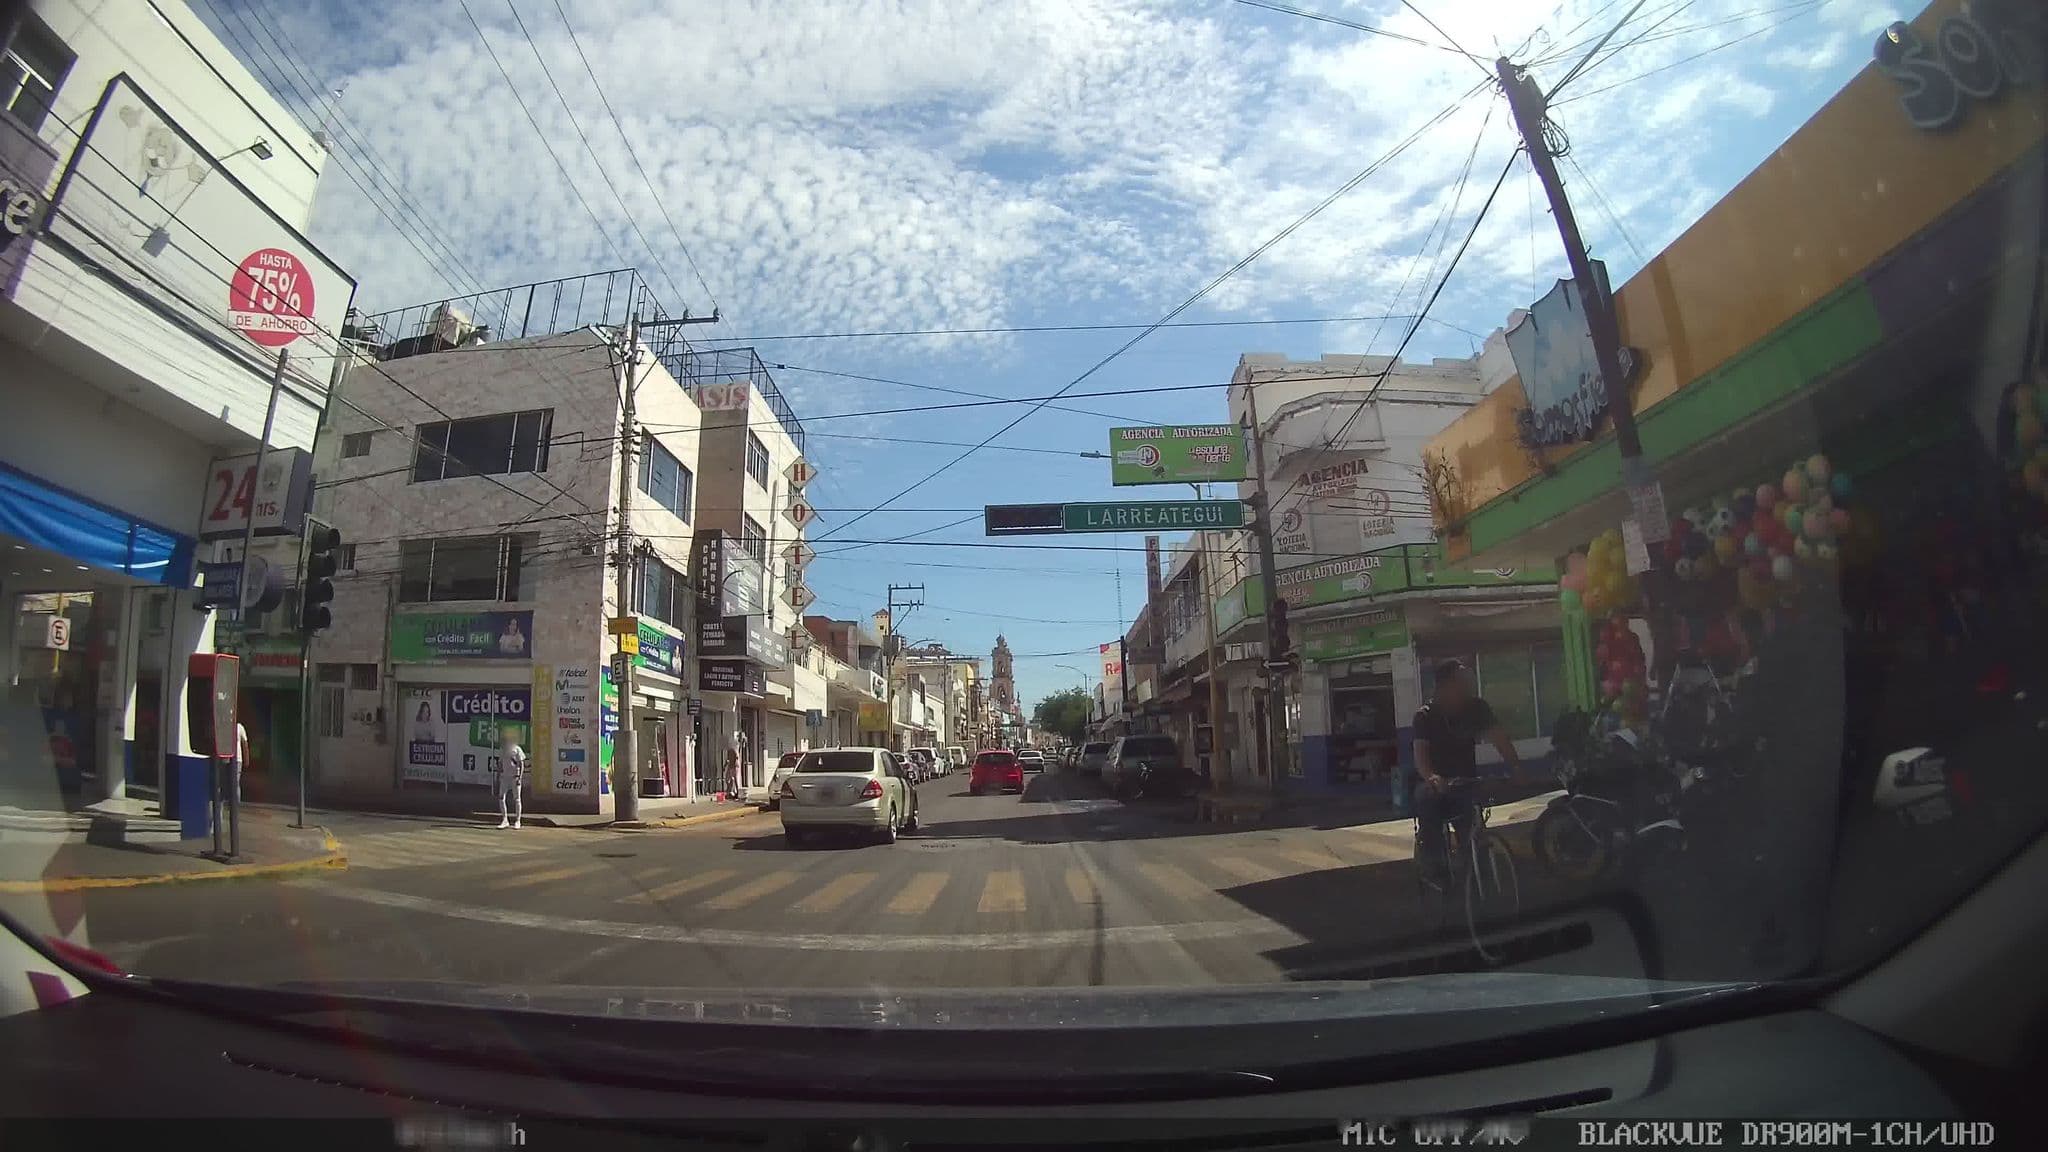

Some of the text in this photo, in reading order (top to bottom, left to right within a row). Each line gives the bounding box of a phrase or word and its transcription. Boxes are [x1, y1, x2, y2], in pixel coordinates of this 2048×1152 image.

[259, 253, 293, 270] HASTA
[247, 266, 301, 314] 75%
[236, 315, 308, 331] DE AHORRO
[1121, 426, 1233, 440] AGENCIA AUTORIZADA
[1297, 458, 1369, 488] AGENCIA
[208, 465, 258, 521] 24
[1087, 506, 1223, 525] LARREATEGUI
[1362, 516, 1395, 531] LOTERIA
[791, 463, 807, 650] HOTEL
[1313, 556, 1381, 579] AUTORIZADA
[451, 693, 525, 715] Crédito
